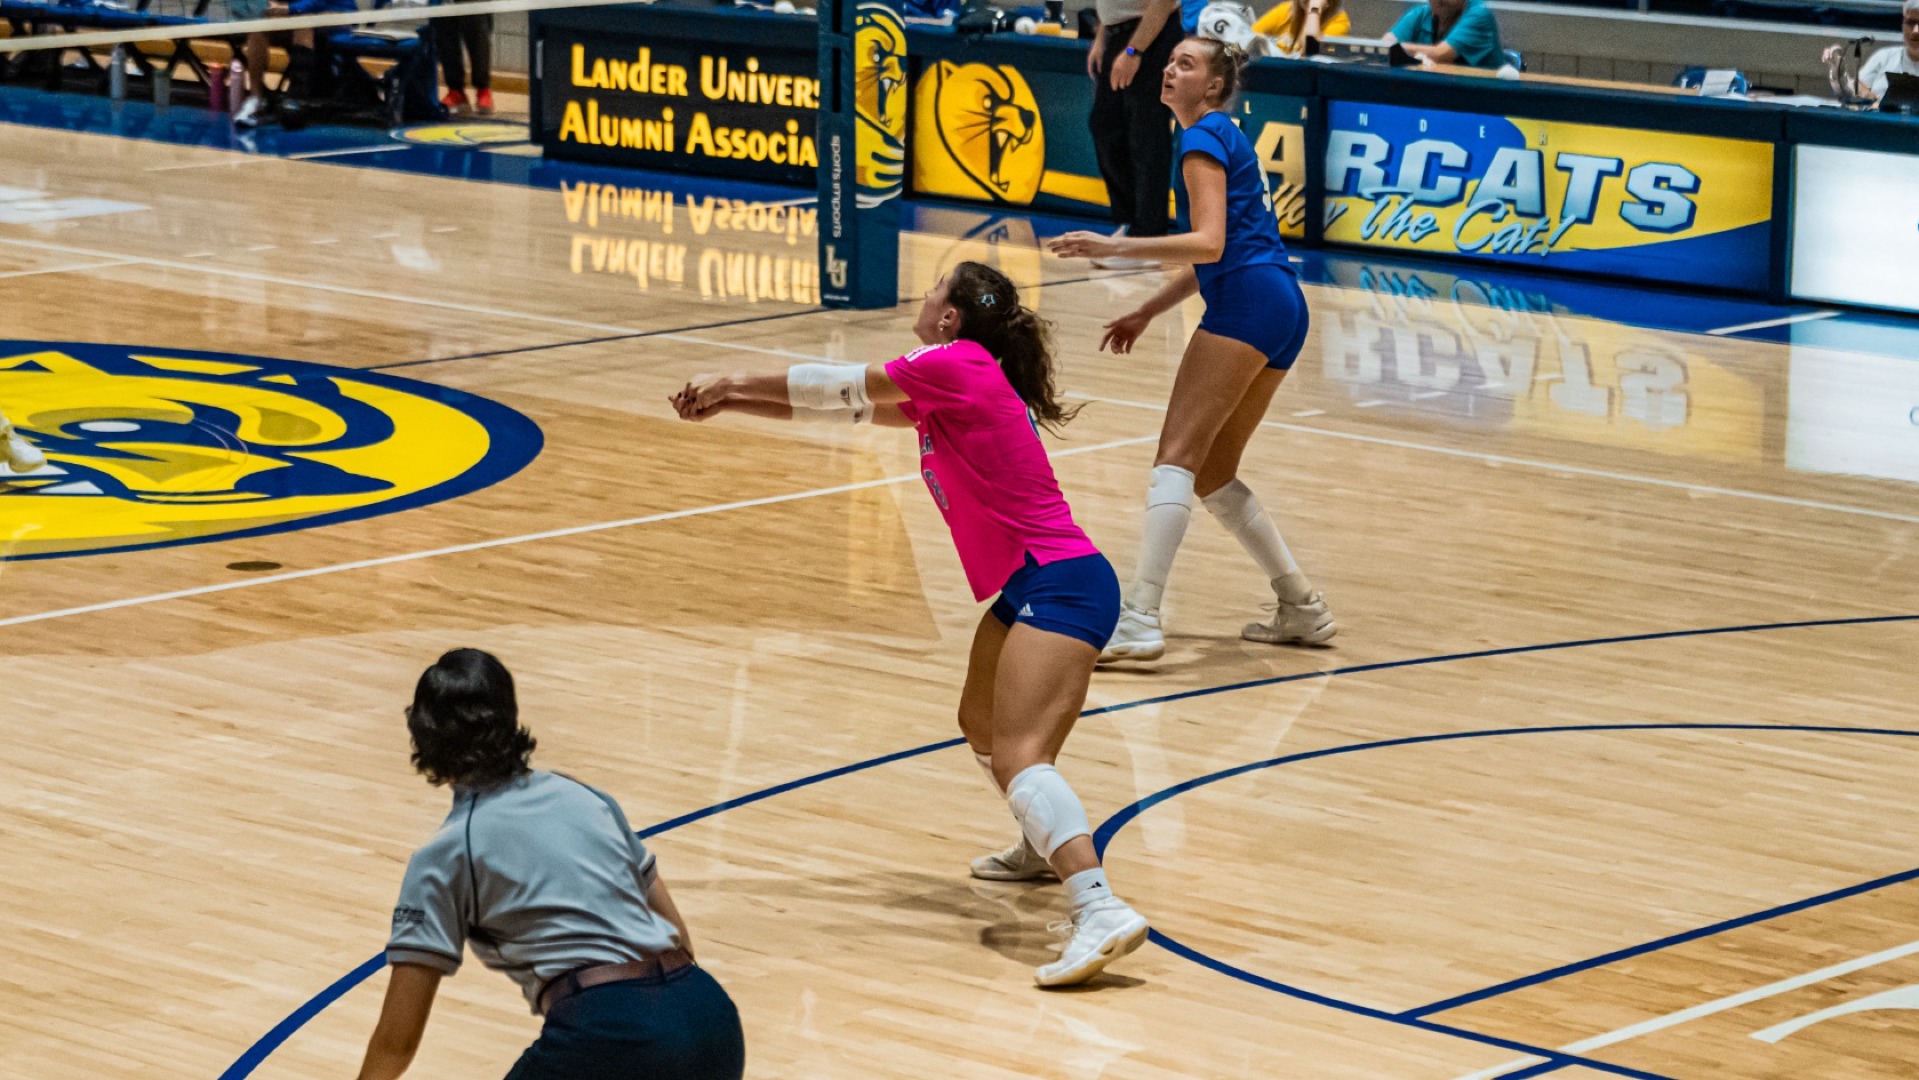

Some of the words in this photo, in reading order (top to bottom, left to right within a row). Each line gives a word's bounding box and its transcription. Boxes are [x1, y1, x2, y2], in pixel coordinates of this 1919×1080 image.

[831, 135, 842, 180] sports
[831, 183, 842, 238] imports
[1358, 186, 1440, 242] The
